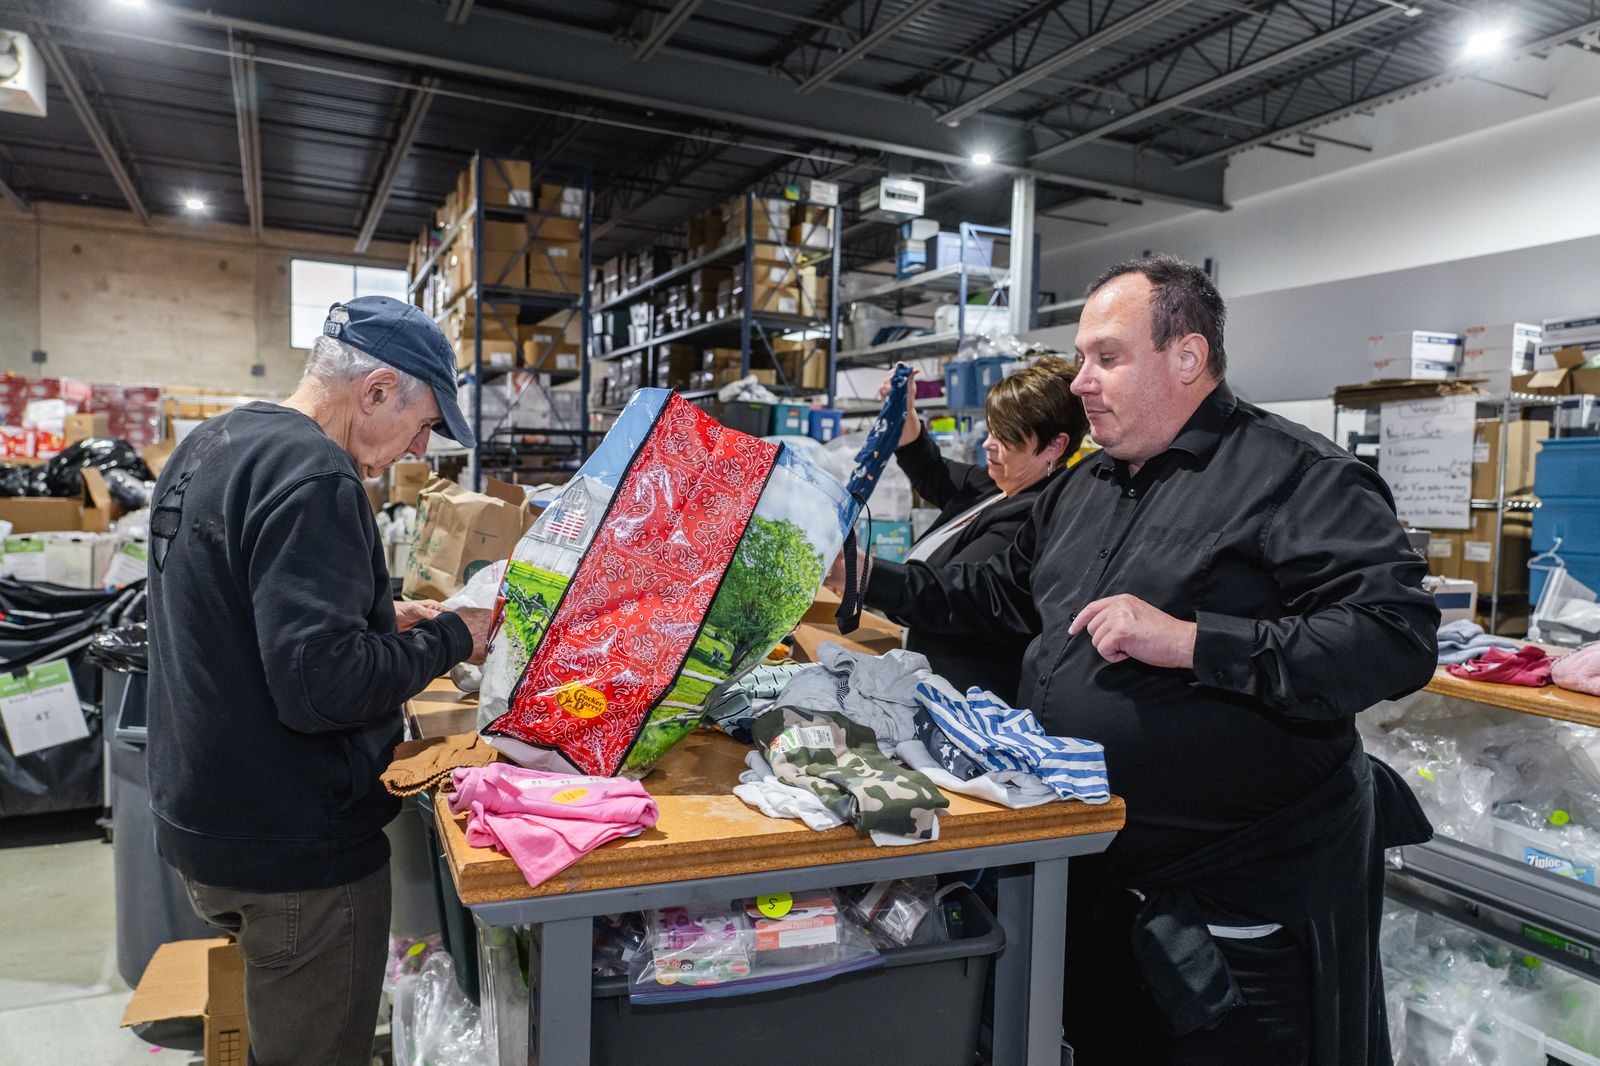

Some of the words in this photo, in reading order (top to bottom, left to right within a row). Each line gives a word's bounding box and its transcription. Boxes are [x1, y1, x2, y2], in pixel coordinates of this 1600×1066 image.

[574, 689, 604, 707] Cracker
[575, 699, 603, 712] Barrel
[36, 711, 50, 721] 4T
[1527, 855, 1561, 868] Ziploc
